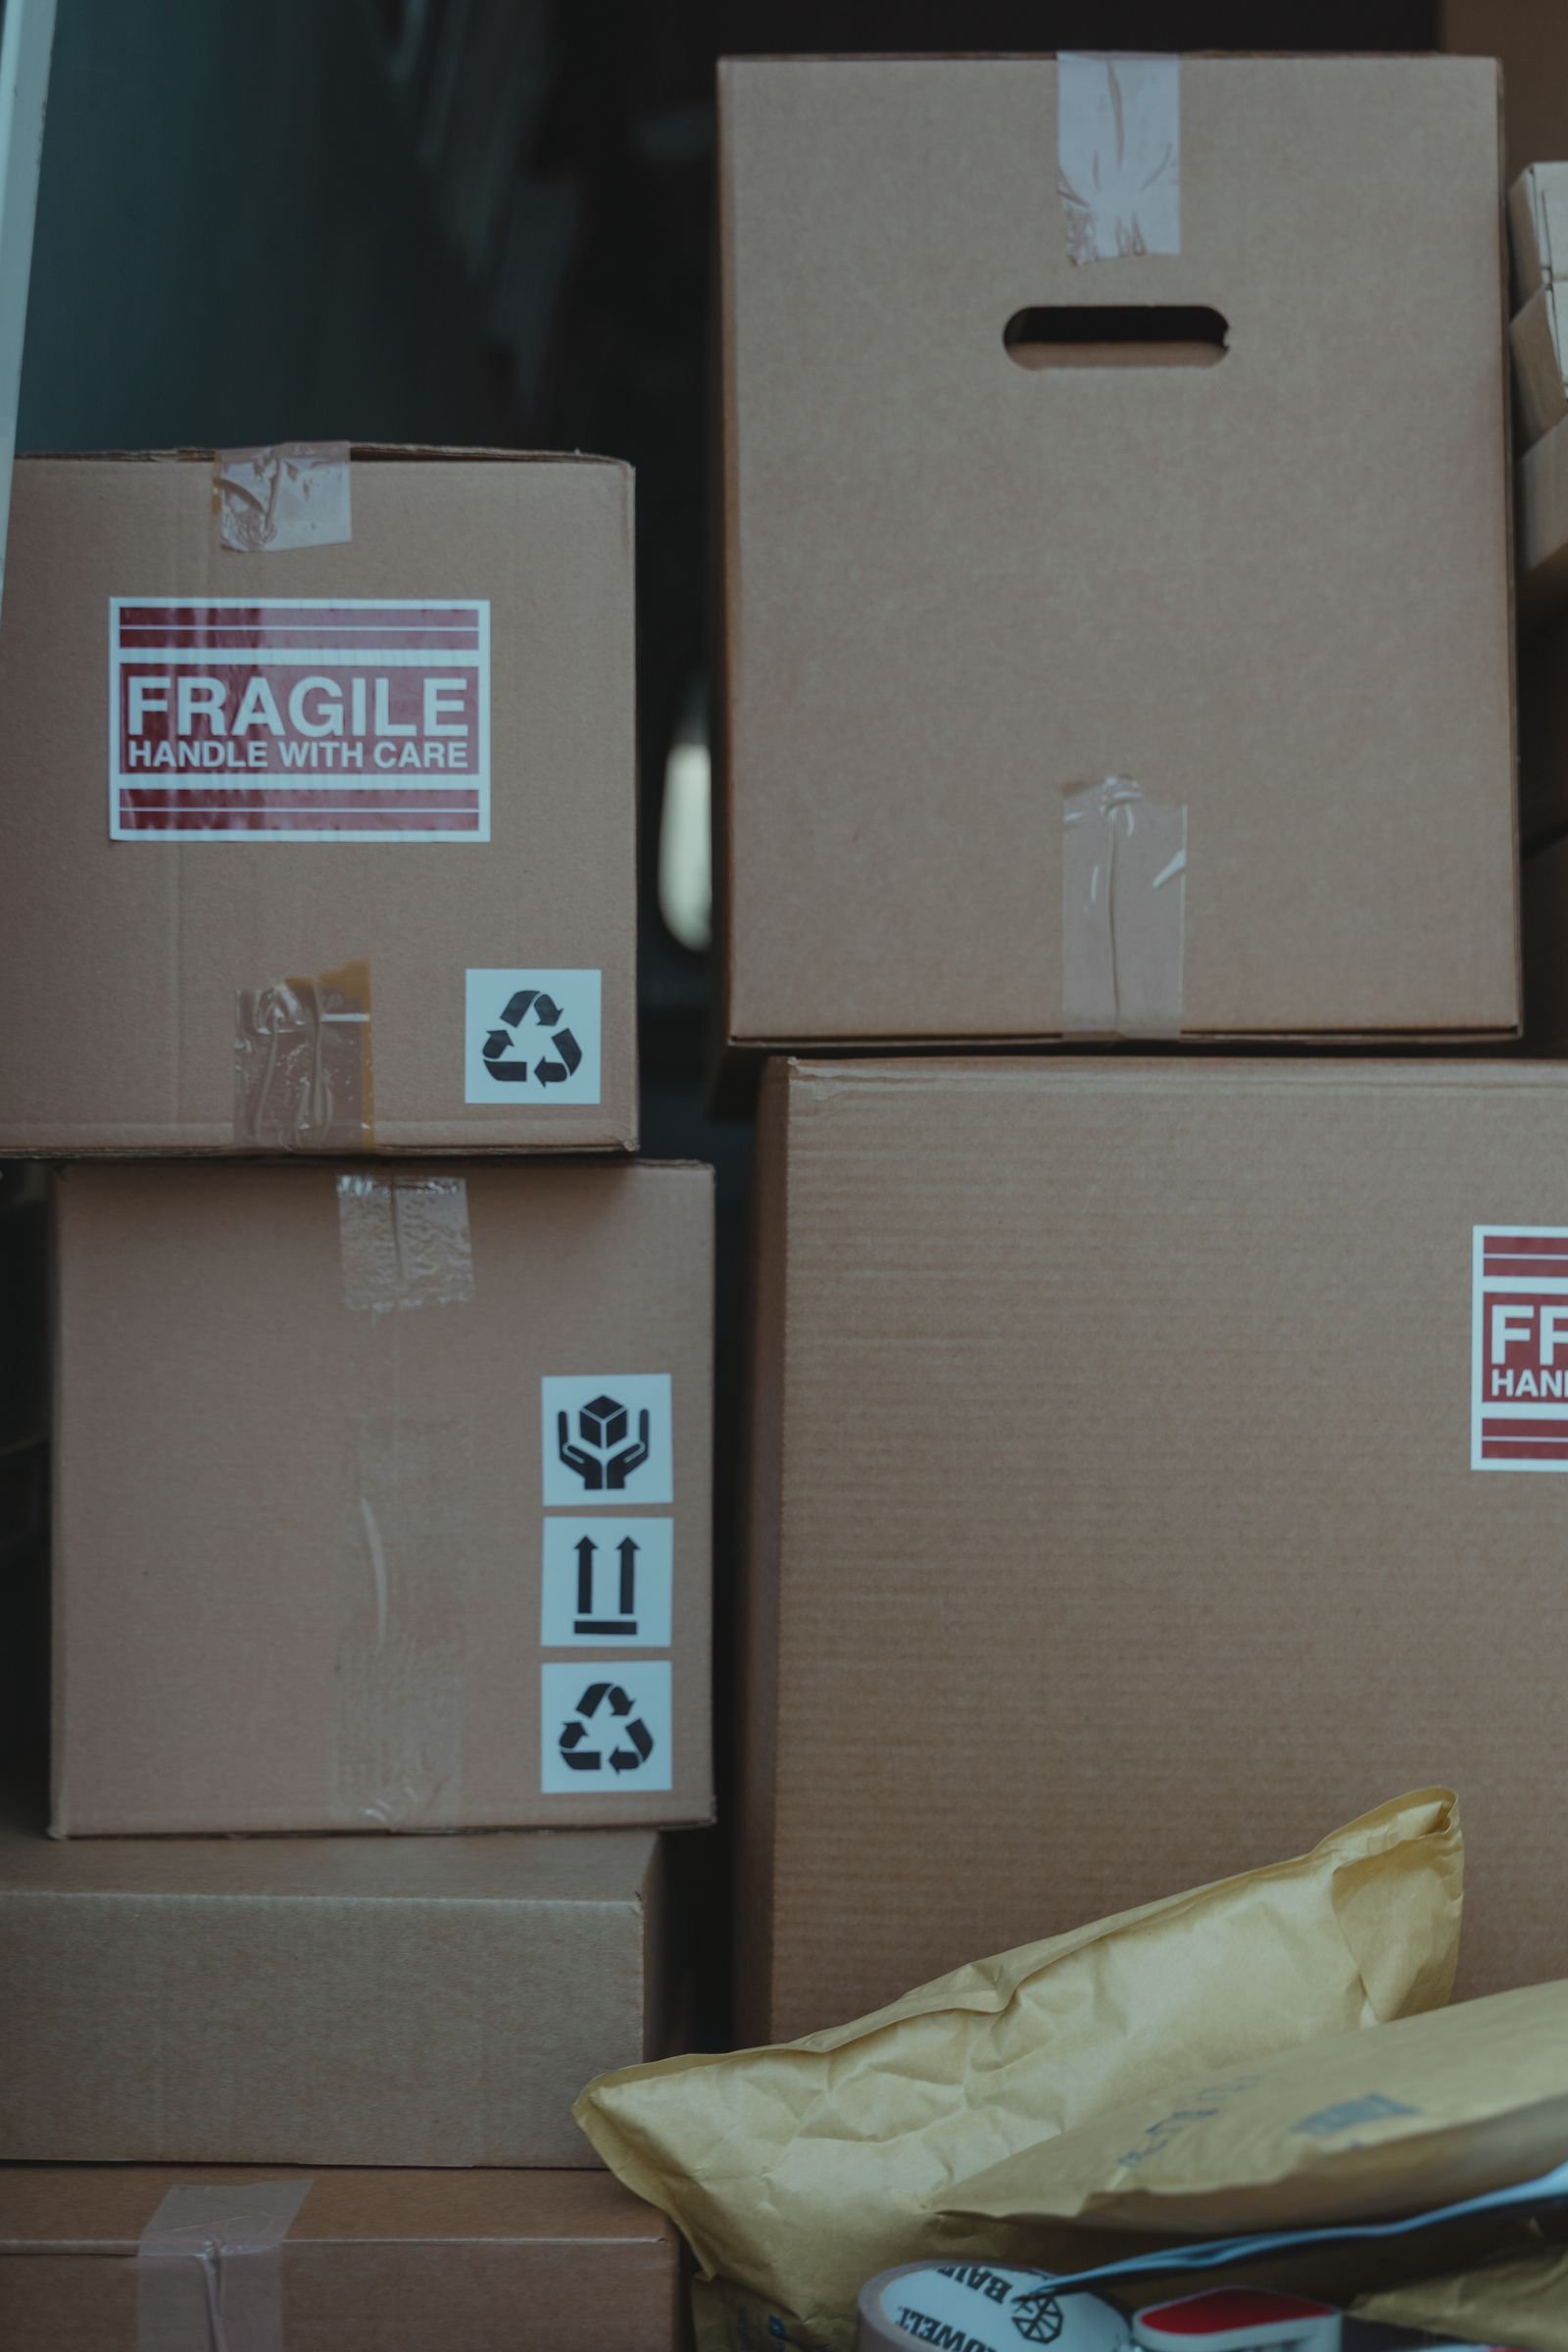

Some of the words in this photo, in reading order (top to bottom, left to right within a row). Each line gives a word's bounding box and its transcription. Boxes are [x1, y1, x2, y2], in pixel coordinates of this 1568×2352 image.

[127, 675, 468, 738] FRAGILE
[128, 740, 268, 767] HANDLE
[278, 741, 364, 767] WITH
[373, 741, 468, 768] CARE
[1492, 1368, 1568, 1397] HAN
